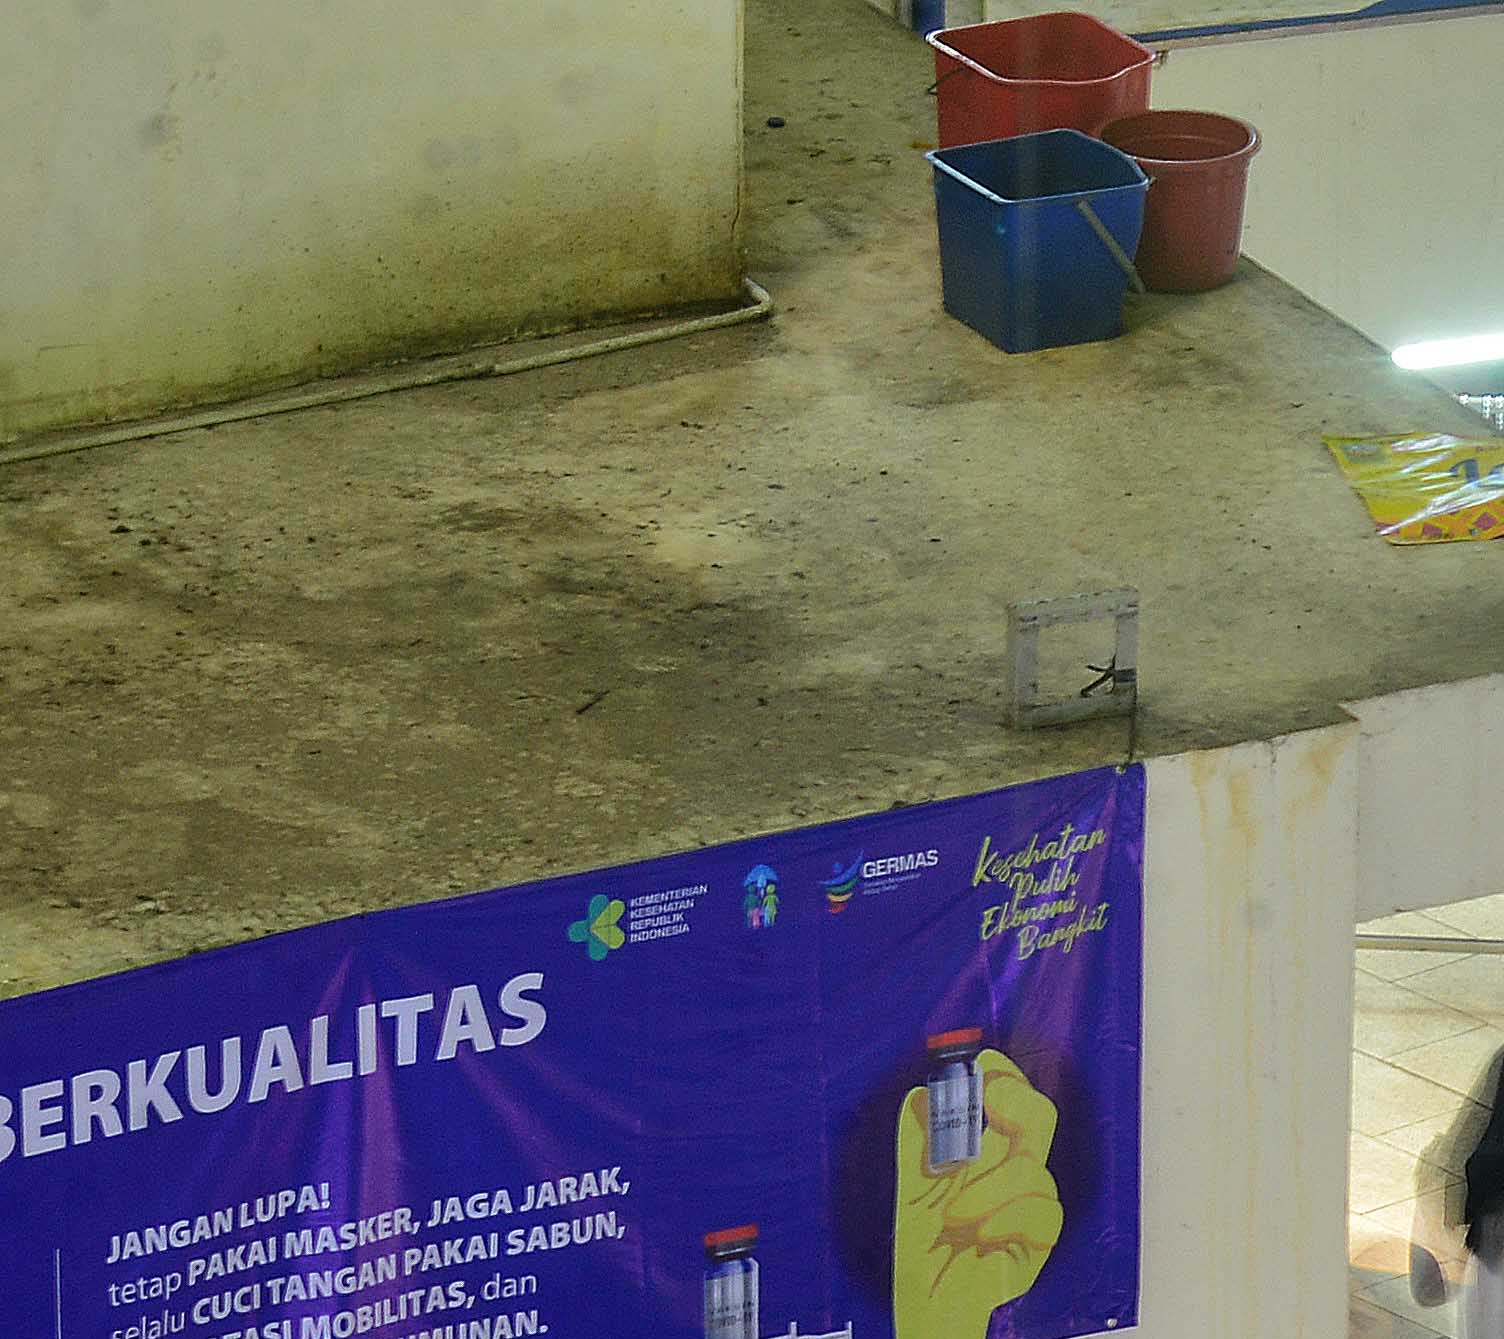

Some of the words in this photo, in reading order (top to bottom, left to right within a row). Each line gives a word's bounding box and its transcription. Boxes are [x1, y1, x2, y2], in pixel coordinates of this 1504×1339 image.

[862, 849, 938, 879] GERMAS
[971, 823, 1106, 889] Kesehatan
[630, 883, 708, 907] KEMENTERIAN
[630, 898, 695, 919] KESEHATAN
[980, 890, 1077, 941] Ekonomi
[630, 912, 684, 932] REPUBLIK
[630, 922, 690, 944] INDONESIA
[1016, 902, 1110, 961] Bangkit
[106, 1205, 234, 1264] JANGAN
[239, 1183, 331, 1225] LUPA!
[108, 1268, 182, 1307] tetap
[188, 1237, 277, 1287] PAKAI
[284, 1208, 420, 1259] MASKER,
[427, 1188, 514, 1228] JAGA
[519, 1166, 630, 1213] JARAK,
[191, 1284, 262, 1325] CUCI
[267, 1253, 397, 1305] TANGAN
[403, 1231, 499, 1279] PAKAI
[506, 1210, 626, 1256] SABUN,
[481, 1271, 538, 1302] dan
